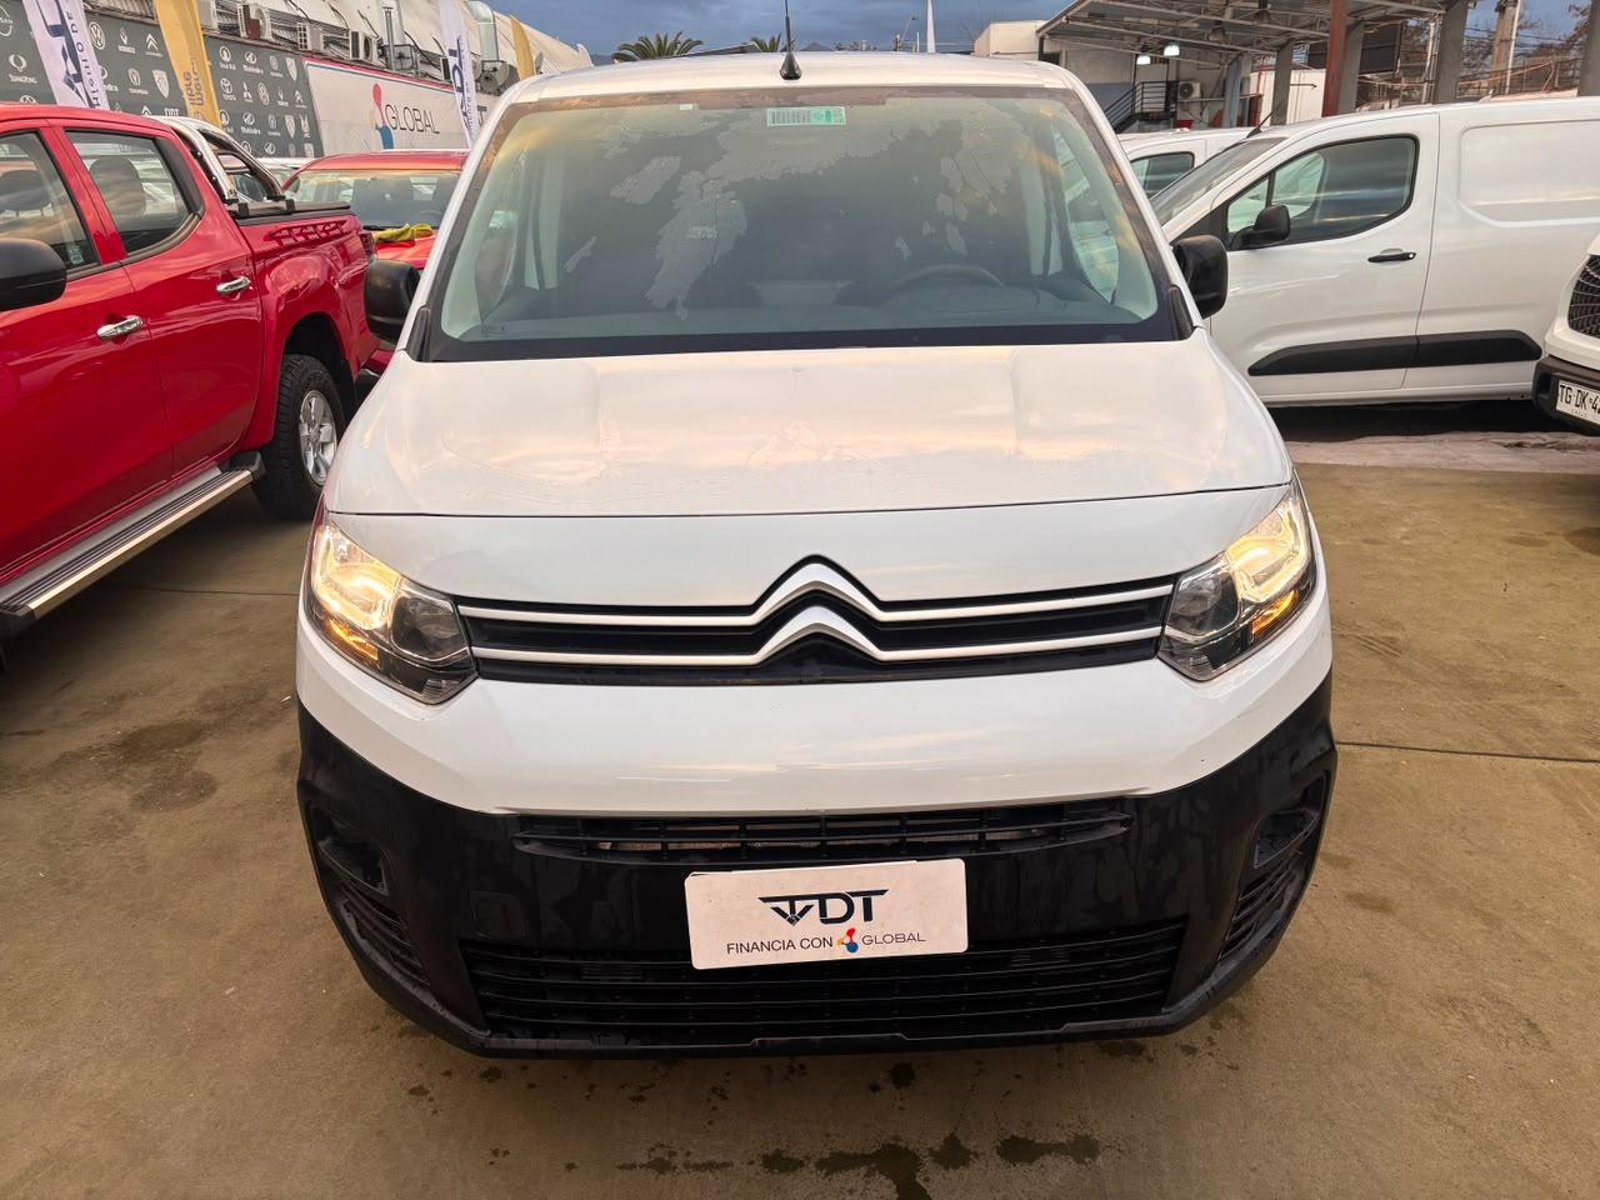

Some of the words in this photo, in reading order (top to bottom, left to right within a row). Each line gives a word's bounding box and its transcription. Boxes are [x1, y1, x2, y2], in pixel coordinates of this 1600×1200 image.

[384, 104, 440, 135] GLOBAL
[726, 940, 796, 955] FINANCIA
[799, 937, 833, 951] CON
[862, 932, 926, 946] GLOBAL
